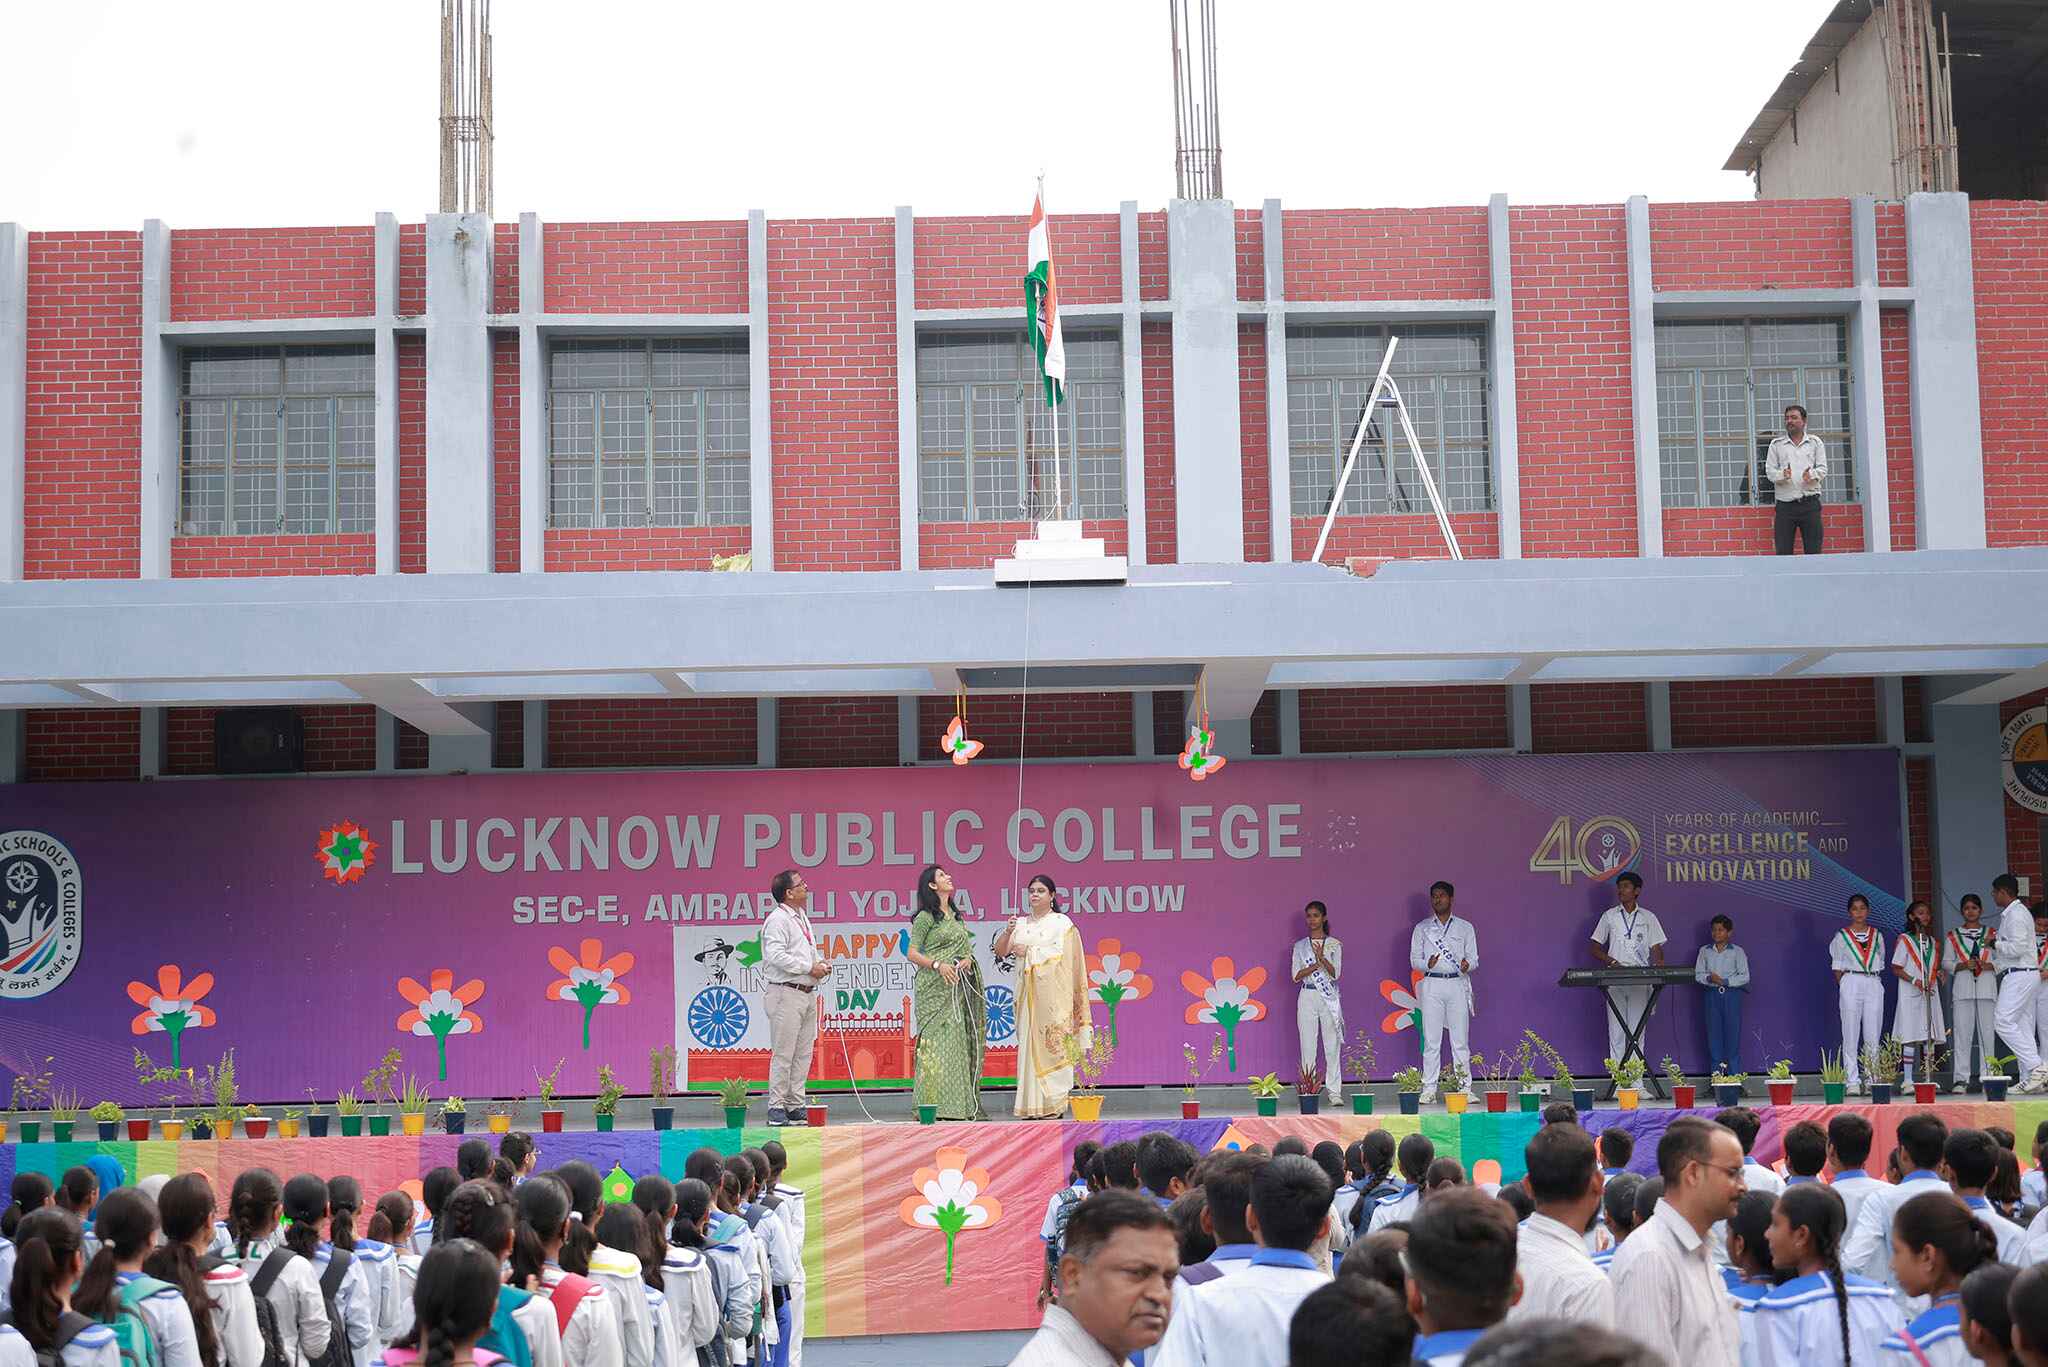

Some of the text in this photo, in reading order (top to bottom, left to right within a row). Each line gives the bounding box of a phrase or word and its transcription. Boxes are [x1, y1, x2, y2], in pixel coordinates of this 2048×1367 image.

[1665, 811, 1821, 827] YEARS OF ACADEMIC
[392, 804, 1302, 873] LUCKNOW PUBLIC COLLEGE
[1530, 815, 1641, 885] 40
[1666, 831, 1849, 856] EXCELLENCE AND
[1666, 859, 1811, 882] INNOVATION
[14, 836, 76, 939] SCHOOLS & COLLEGES
[513, 895, 630, 926] SEC-E,
[645, 890, 838, 922] AMRAPLI
[850, 888, 985, 919] YOJA,
[814, 933, 899, 960] HAPPY
[836, 989, 881, 1011] DAY
